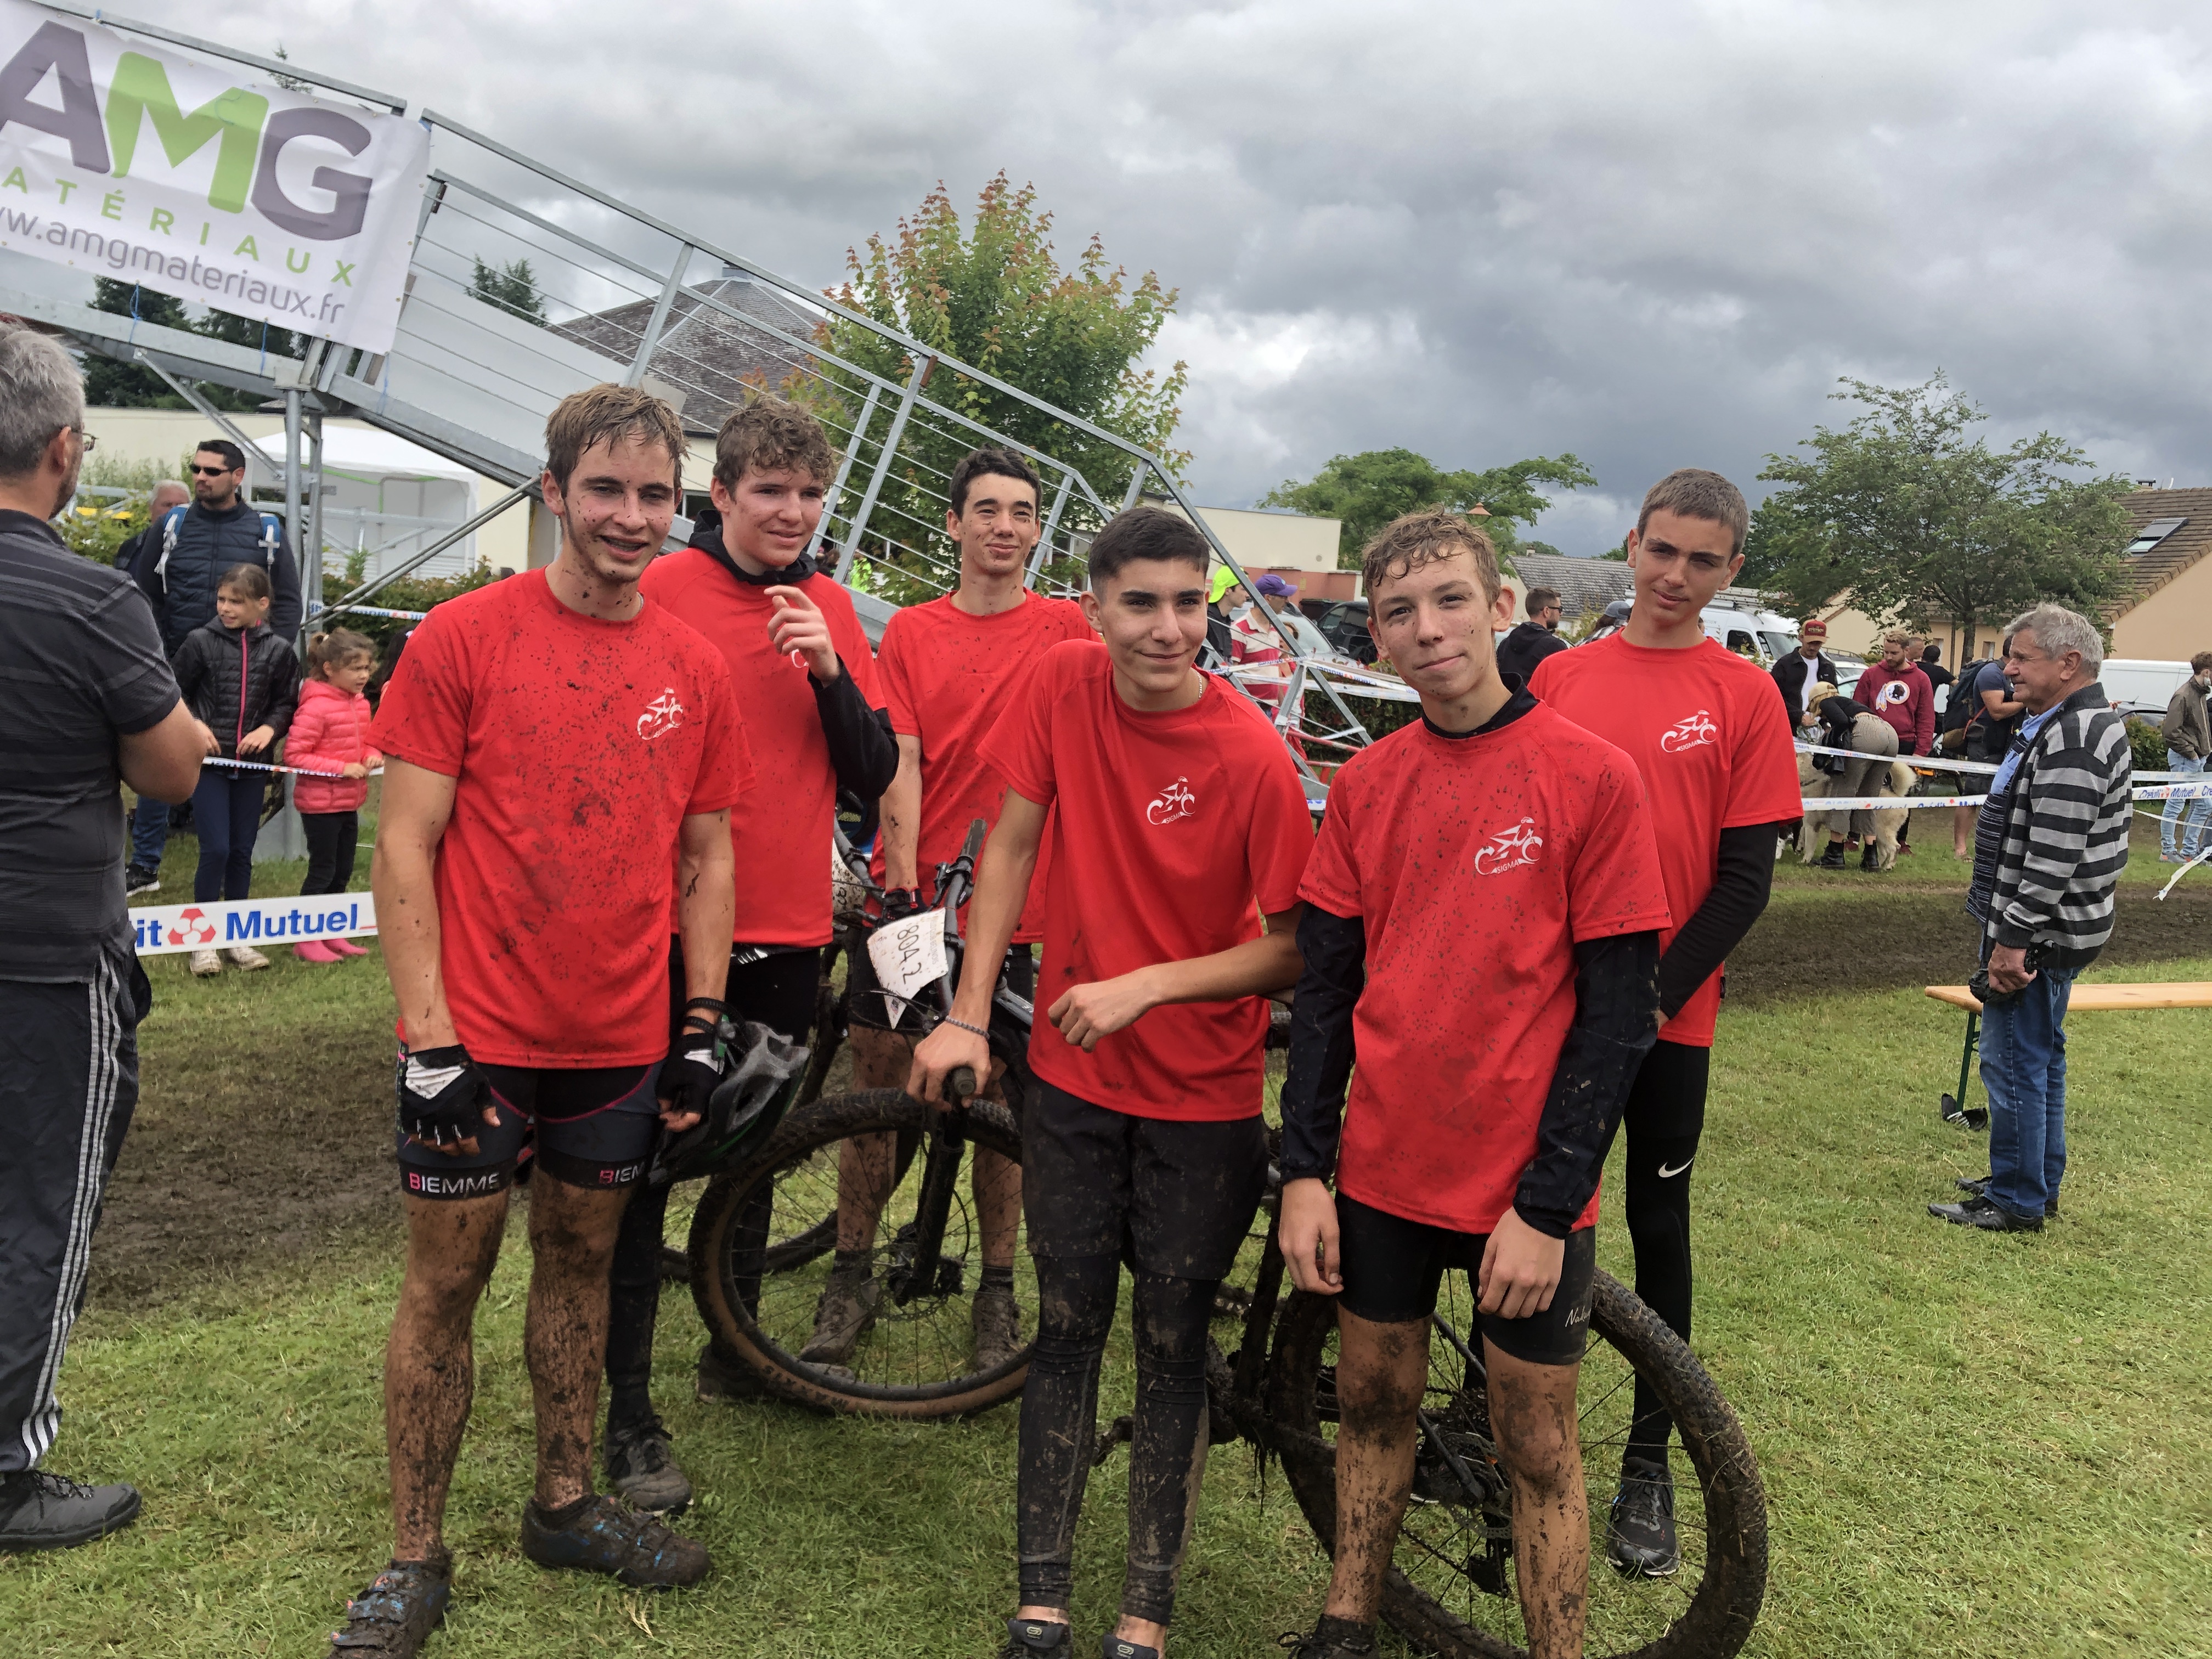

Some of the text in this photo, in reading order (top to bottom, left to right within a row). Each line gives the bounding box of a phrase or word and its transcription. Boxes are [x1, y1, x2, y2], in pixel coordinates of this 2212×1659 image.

[0, 20, 374, 241] AMG
[1680, 741, 1698, 752] SIGMA
[1166, 812, 1182, 823] SIGMA
[1497, 859, 1519, 874] SIGMA
[225, 903, 358, 941] Mutuel
[409, 1172, 499, 1194] BIEMME
